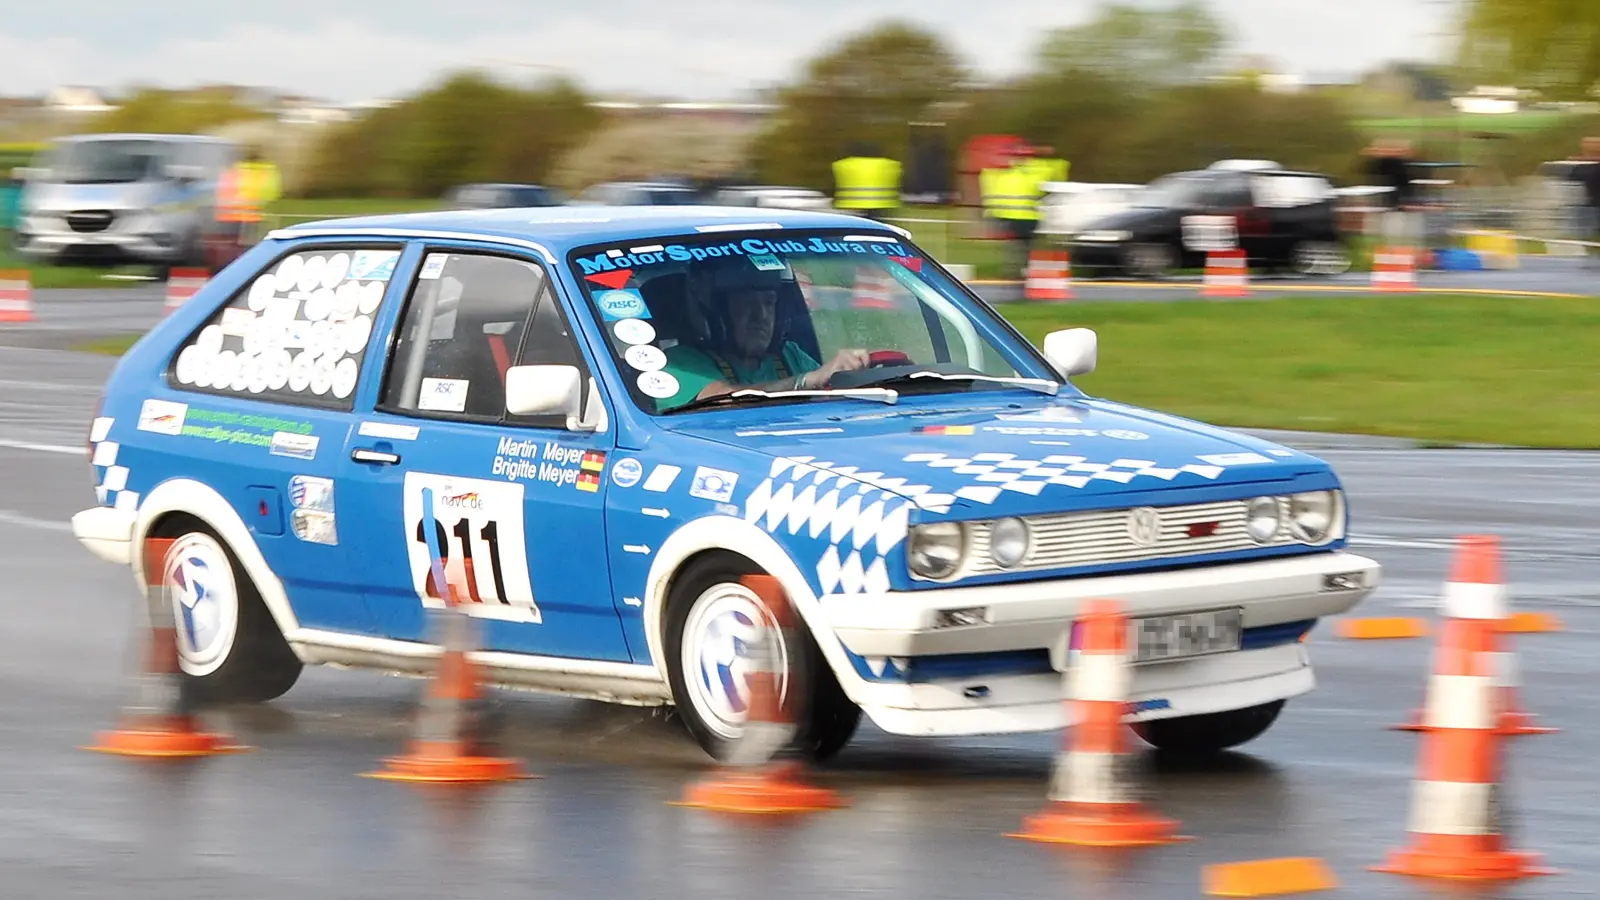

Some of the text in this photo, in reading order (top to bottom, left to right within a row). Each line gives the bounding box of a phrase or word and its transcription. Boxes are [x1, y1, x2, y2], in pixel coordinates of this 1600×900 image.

[808, 238, 867, 253] Jura
[607, 300, 637, 309] ASC
[496, 436, 585, 467] Martin Meyer
[492, 456, 581, 488] Brigitte Meyer
[416, 517, 511, 607] 211
